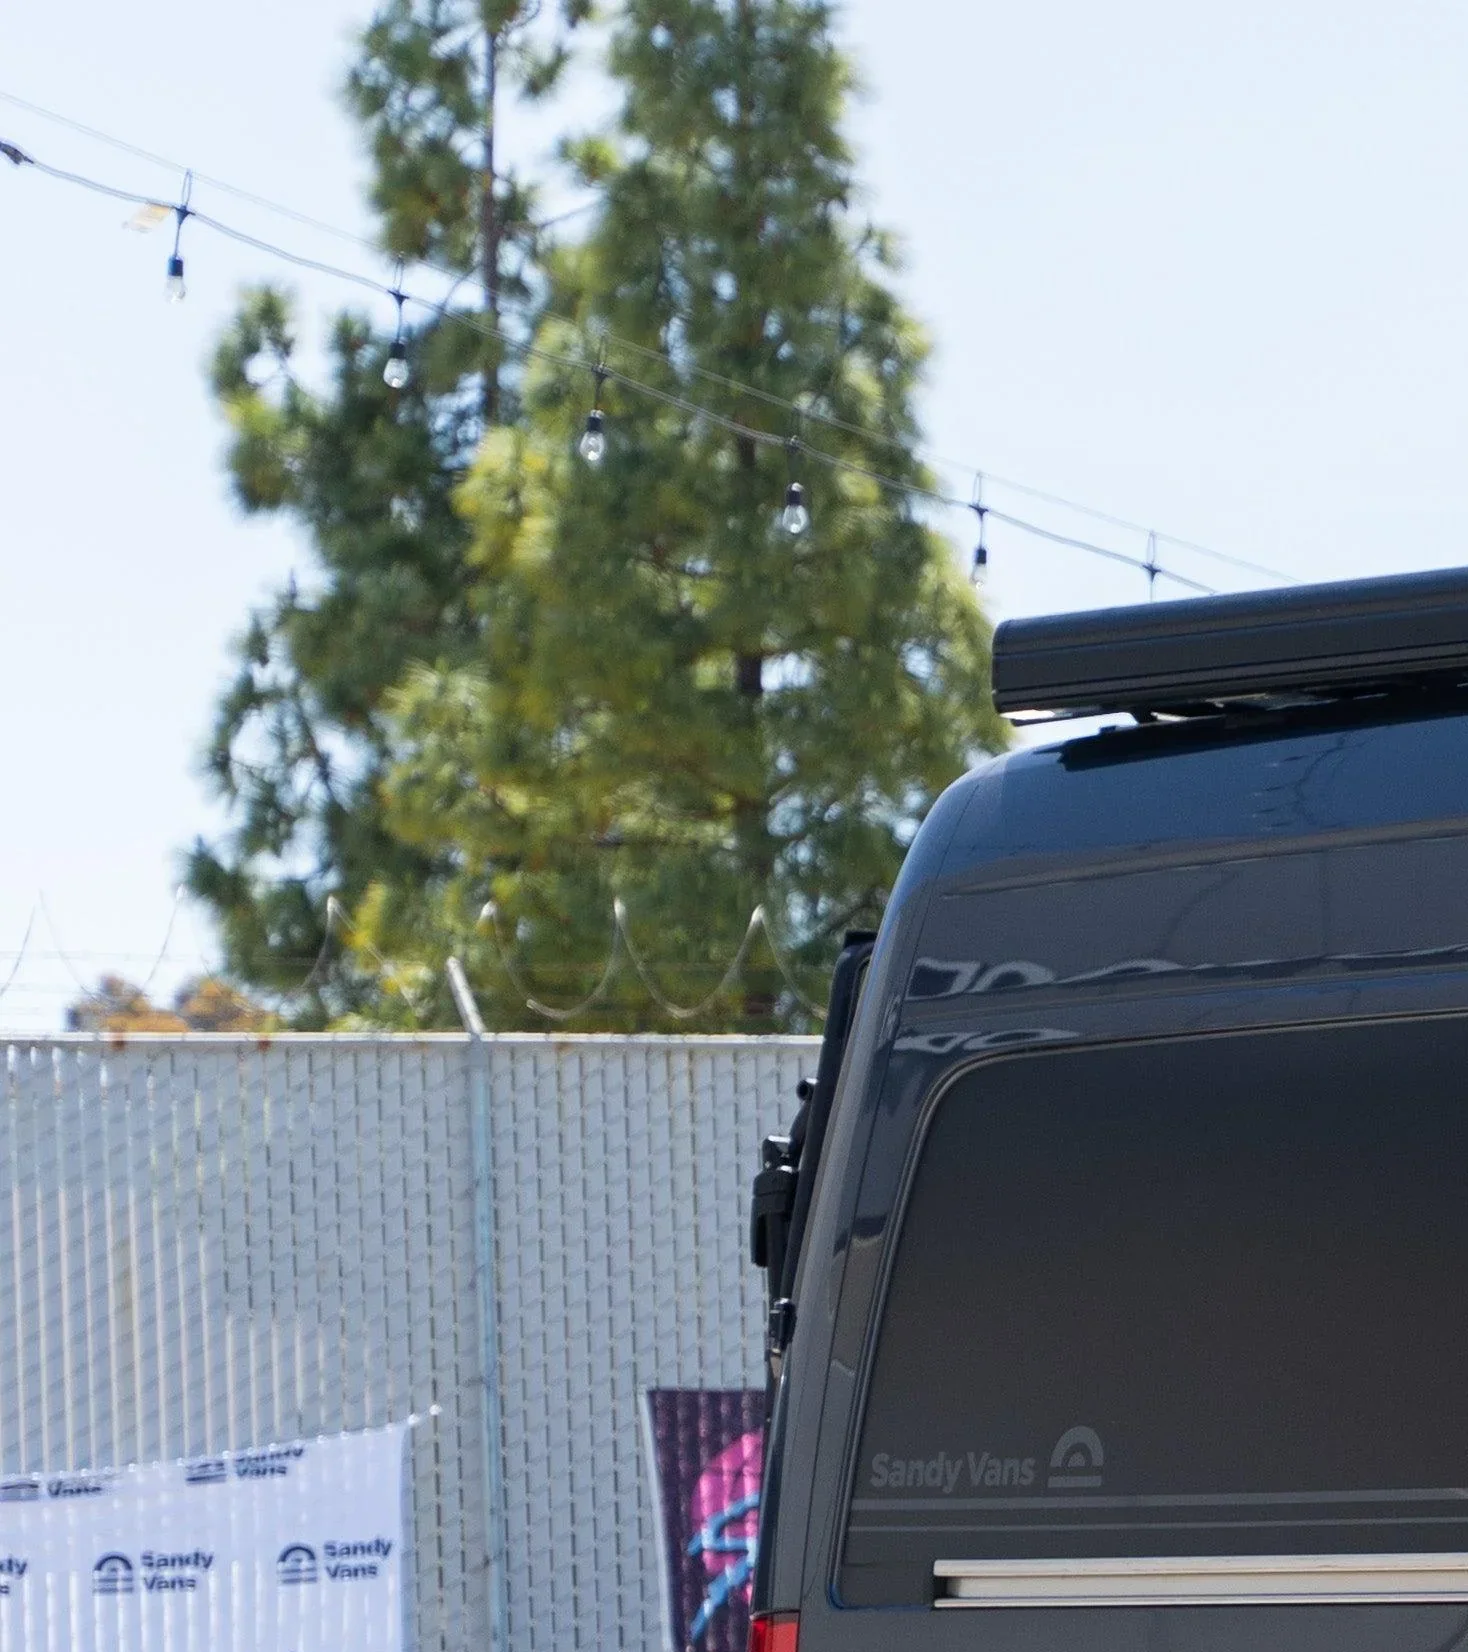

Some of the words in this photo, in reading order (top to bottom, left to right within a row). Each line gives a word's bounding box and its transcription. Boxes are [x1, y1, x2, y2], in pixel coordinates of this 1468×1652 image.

[870, 1452, 963, 1493] Sandy
[966, 1452, 1036, 1486] Vans
[323, 1535, 393, 1558] Sandy
[140, 1550, 214, 1570] Sandy
[325, 1562, 379, 1580] Vans
[142, 1574, 197, 1592] Vans
